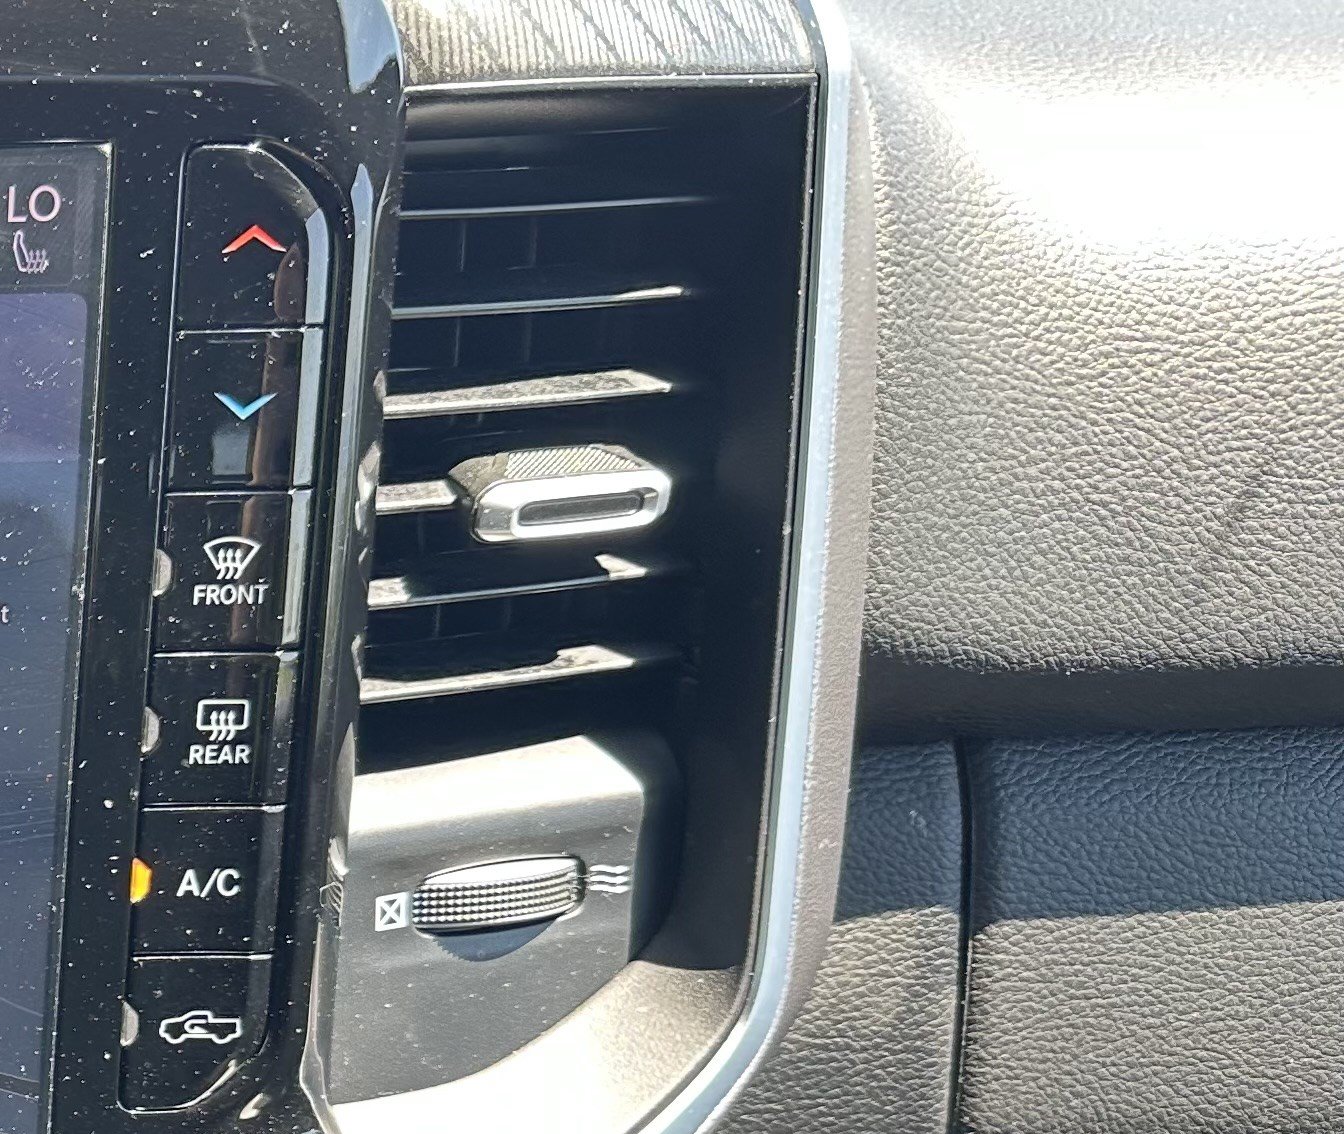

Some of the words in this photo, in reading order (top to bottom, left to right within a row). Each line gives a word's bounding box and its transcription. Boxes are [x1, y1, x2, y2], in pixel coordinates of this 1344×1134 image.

[6, 185, 61, 225] LO
[193, 585, 269, 605] FRONT
[188, 746, 250, 765] REAR
[177, 868, 242, 898] A/C
